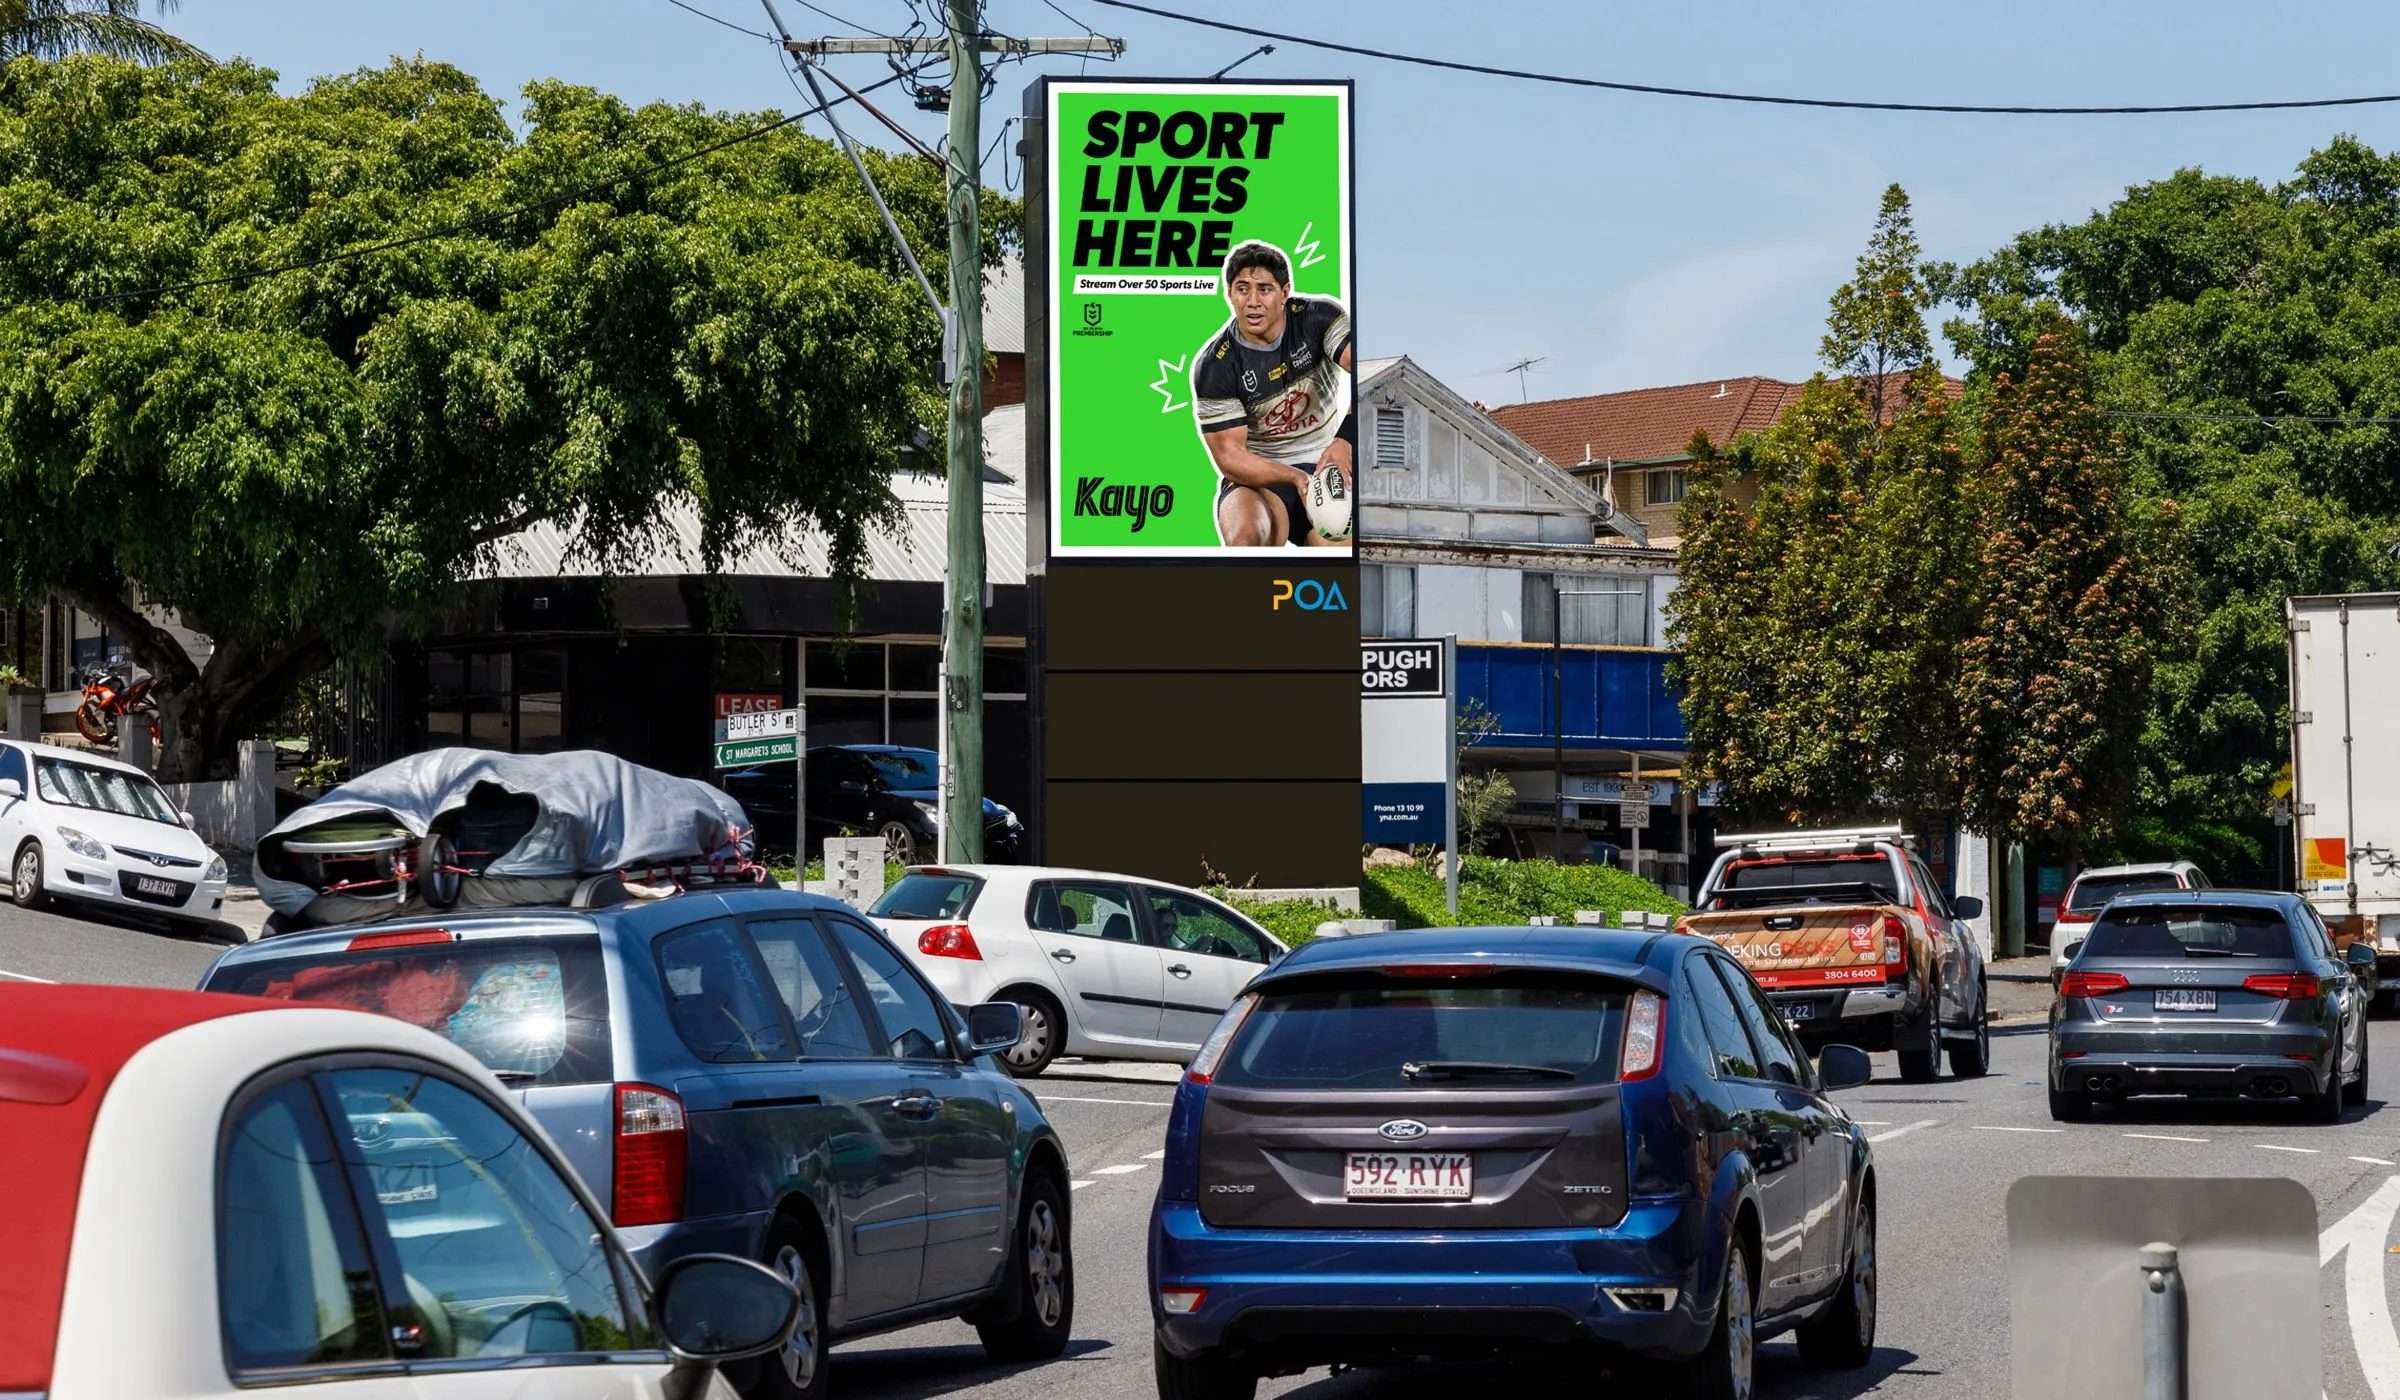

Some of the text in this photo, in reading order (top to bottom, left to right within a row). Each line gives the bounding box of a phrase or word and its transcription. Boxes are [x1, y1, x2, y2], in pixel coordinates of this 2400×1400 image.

[1082, 110, 1286, 160] SPORT
[1080, 164, 1251, 214] LIVES
[1072, 219, 1234, 268] HERE
[1080, 278, 1214, 291] Stream Over 50 Sports Live
[1074, 477, 1125, 533] Kayo
[1273, 579, 1348, 611] POA
[1362, 650, 1432, 670] PUGH
[1361, 671, 1409, 688] ORS
[720, 698, 777, 715] LEASE
[729, 713, 766, 731] BUTLER
[771, 711, 782, 727] ST
[725, 743, 794, 760] ST MARGARETS SCHOOL
[1582, 782, 1601, 793] EST
[1373, 804, 1425, 812] Phone 13 10 99
[1379, 814, 1419, 823] yna.com.au
[1764, 957, 1803, 965] Outdoor
[1824, 970, 1849, 980] 3804
[1851, 968, 1877, 979] 6400
[1388, 1123, 1417, 1136] Ford
[1209, 1185, 1255, 1193] FOCUS
[1351, 1187, 1465, 1196] QUEENSLAND SUNSHINE STATE
[1563, 1185, 1612, 1193] ZETEC
